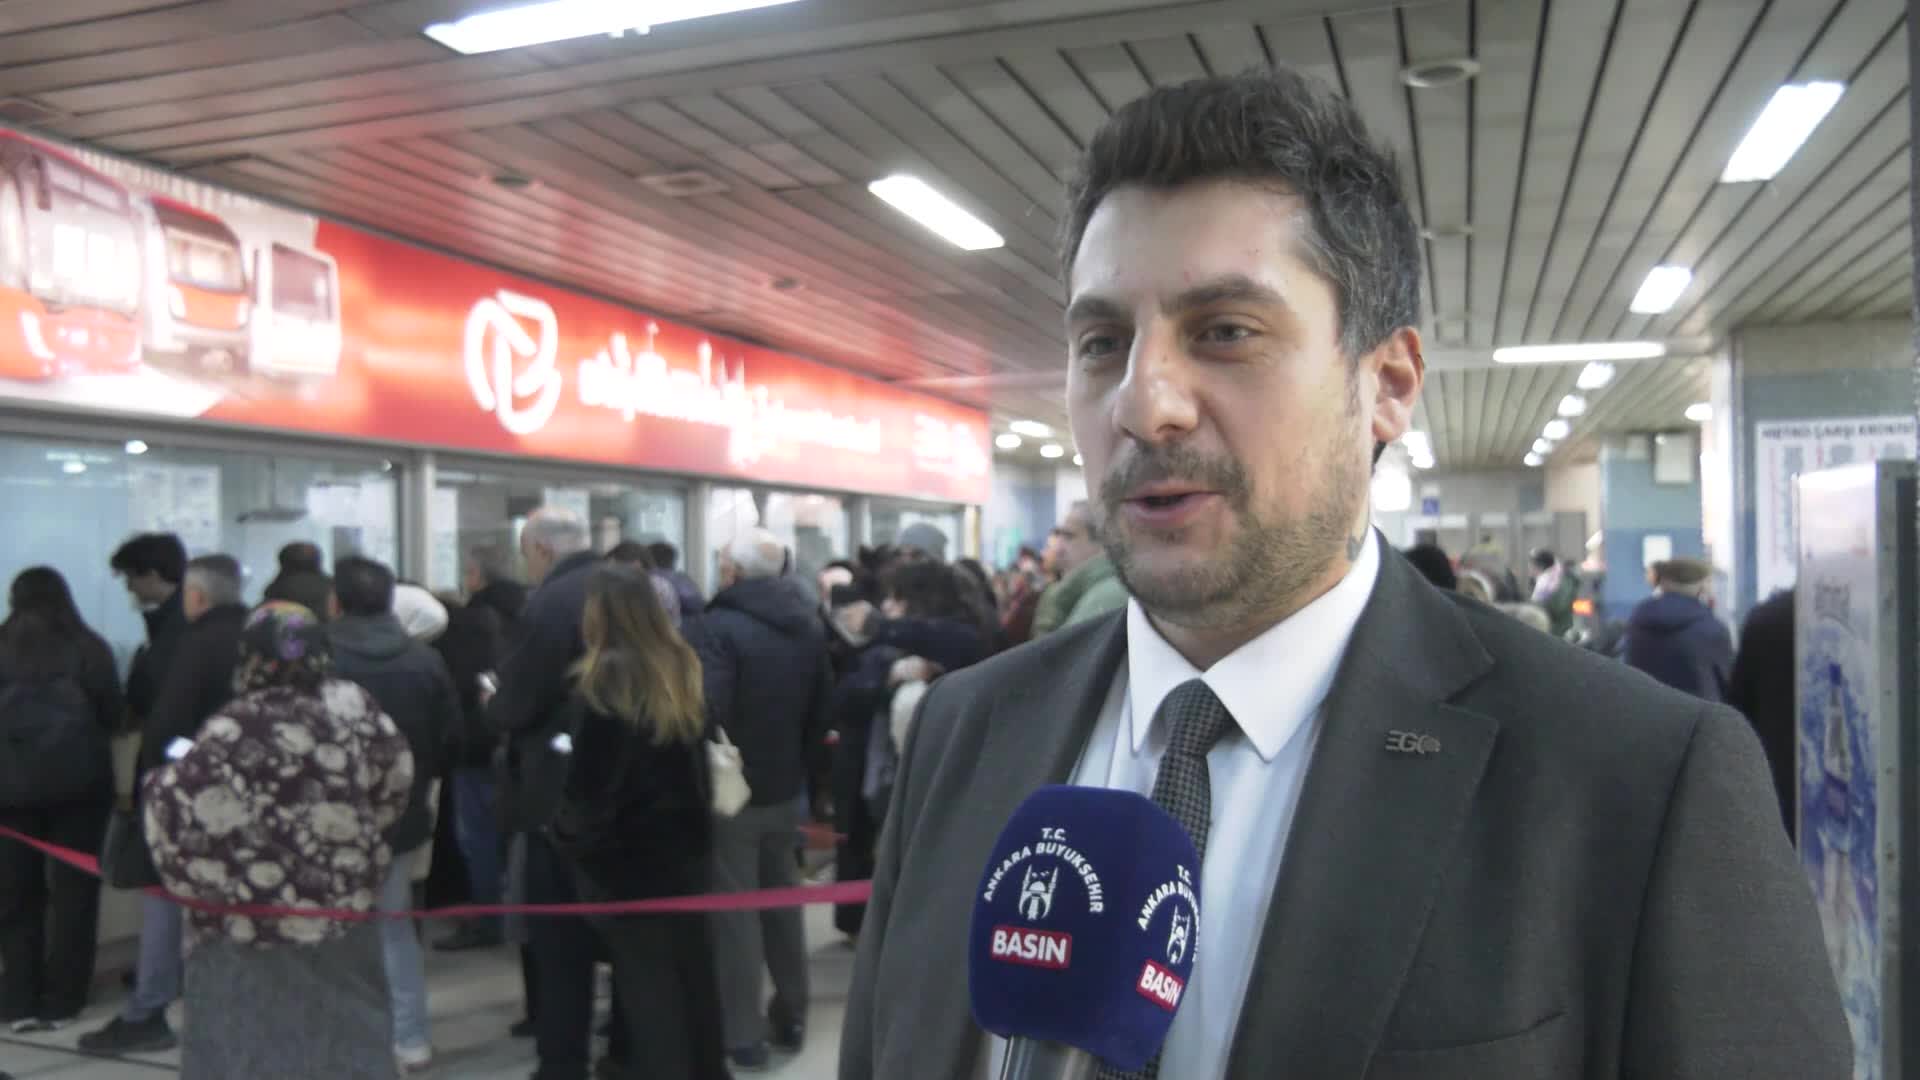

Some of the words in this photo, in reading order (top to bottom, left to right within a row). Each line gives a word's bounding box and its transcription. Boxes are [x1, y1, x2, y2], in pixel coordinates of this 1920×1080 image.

[1041, 827, 1066, 841] T.C.
[983, 846, 1032, 901] ANKARA
[1138, 880, 1177, 931] ANKARA
[992, 929, 1068, 964] BASIN
[1140, 964, 1183, 1007] BASIN
